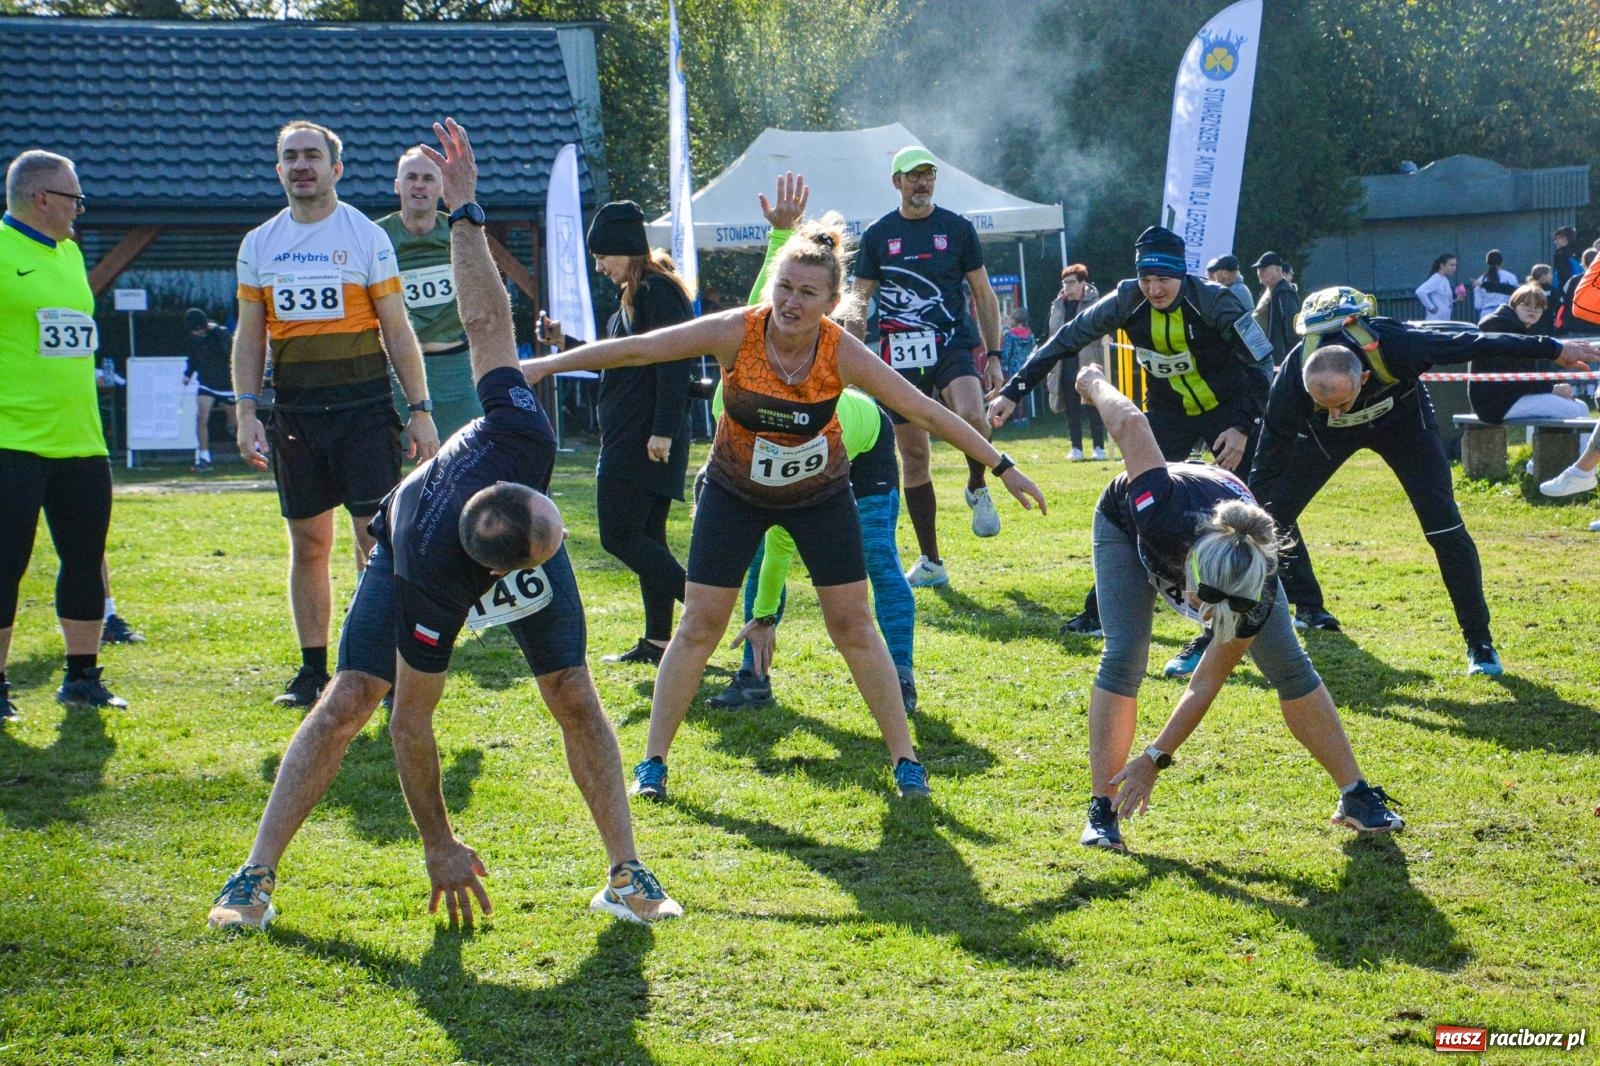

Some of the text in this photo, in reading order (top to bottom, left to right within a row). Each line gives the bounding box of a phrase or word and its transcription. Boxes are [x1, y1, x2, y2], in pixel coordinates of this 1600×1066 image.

[1196, 87, 1226, 153] STOWARZYSZENIE
[1188, 190, 1211, 206] DLA
[1184, 207, 1208, 247] LEPSZEGO
[292, 252, 329, 264] Hybris
[277, 287, 339, 311] 338
[405, 278, 452, 301] 303
[44, 325, 93, 348] 337
[893, 344, 932, 362] 311
[1143, 360, 1190, 374] 159
[792, 410, 810, 425] 10
[758, 453, 823, 478] 169
